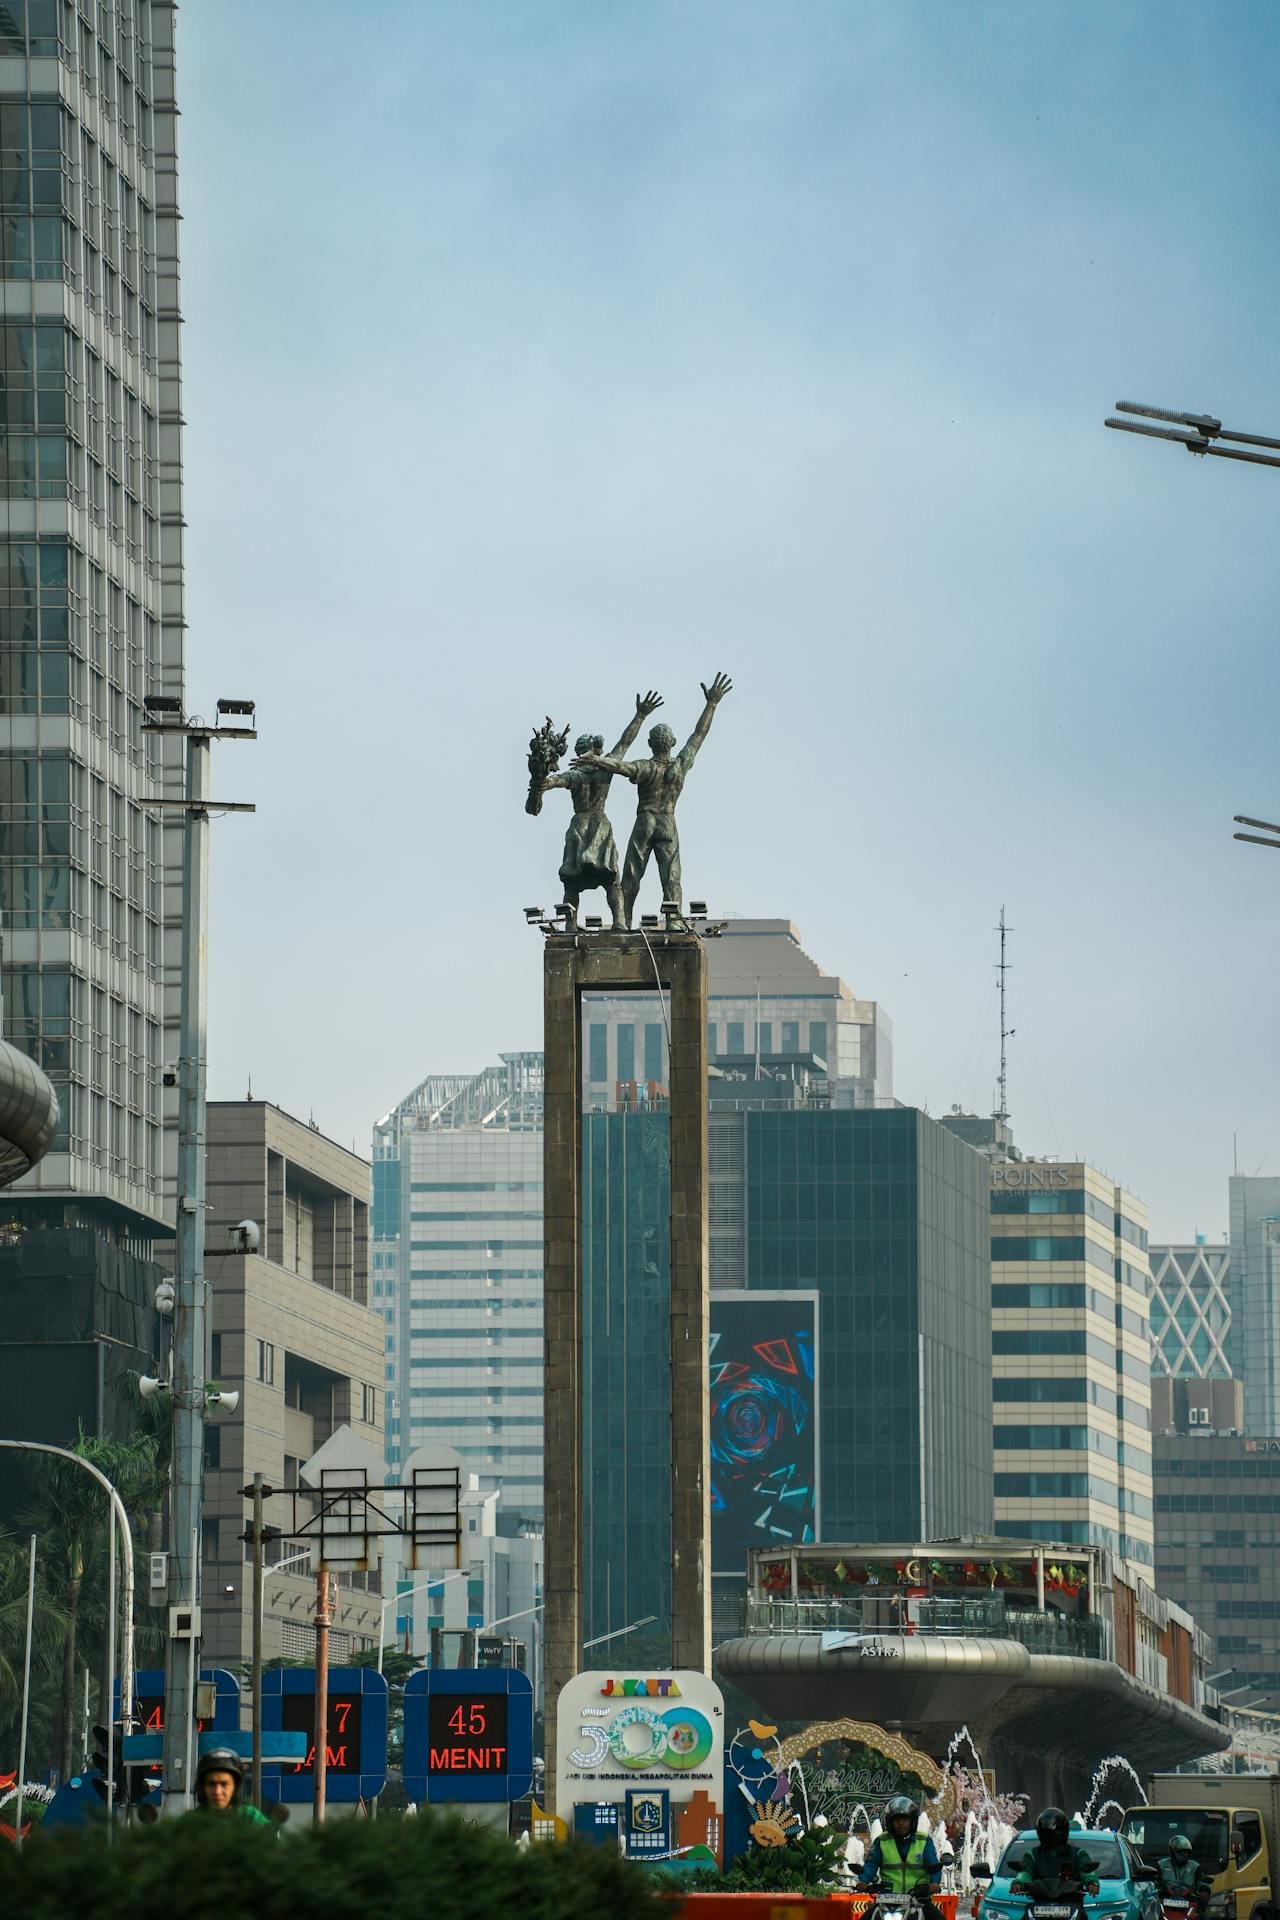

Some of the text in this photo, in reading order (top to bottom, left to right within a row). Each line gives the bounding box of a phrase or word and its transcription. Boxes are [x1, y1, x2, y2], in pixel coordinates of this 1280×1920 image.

[993, 1168, 1069, 1186] POINTS
[860, 1646, 900, 1658] ASTRA
[601, 1680, 682, 1697] JAKARTA
[448, 1704, 486, 1735] 45
[567, 1707, 713, 1770] 500
[430, 1747, 506, 1769] MENIT
[789, 1761, 899, 1794] RAMADAN
